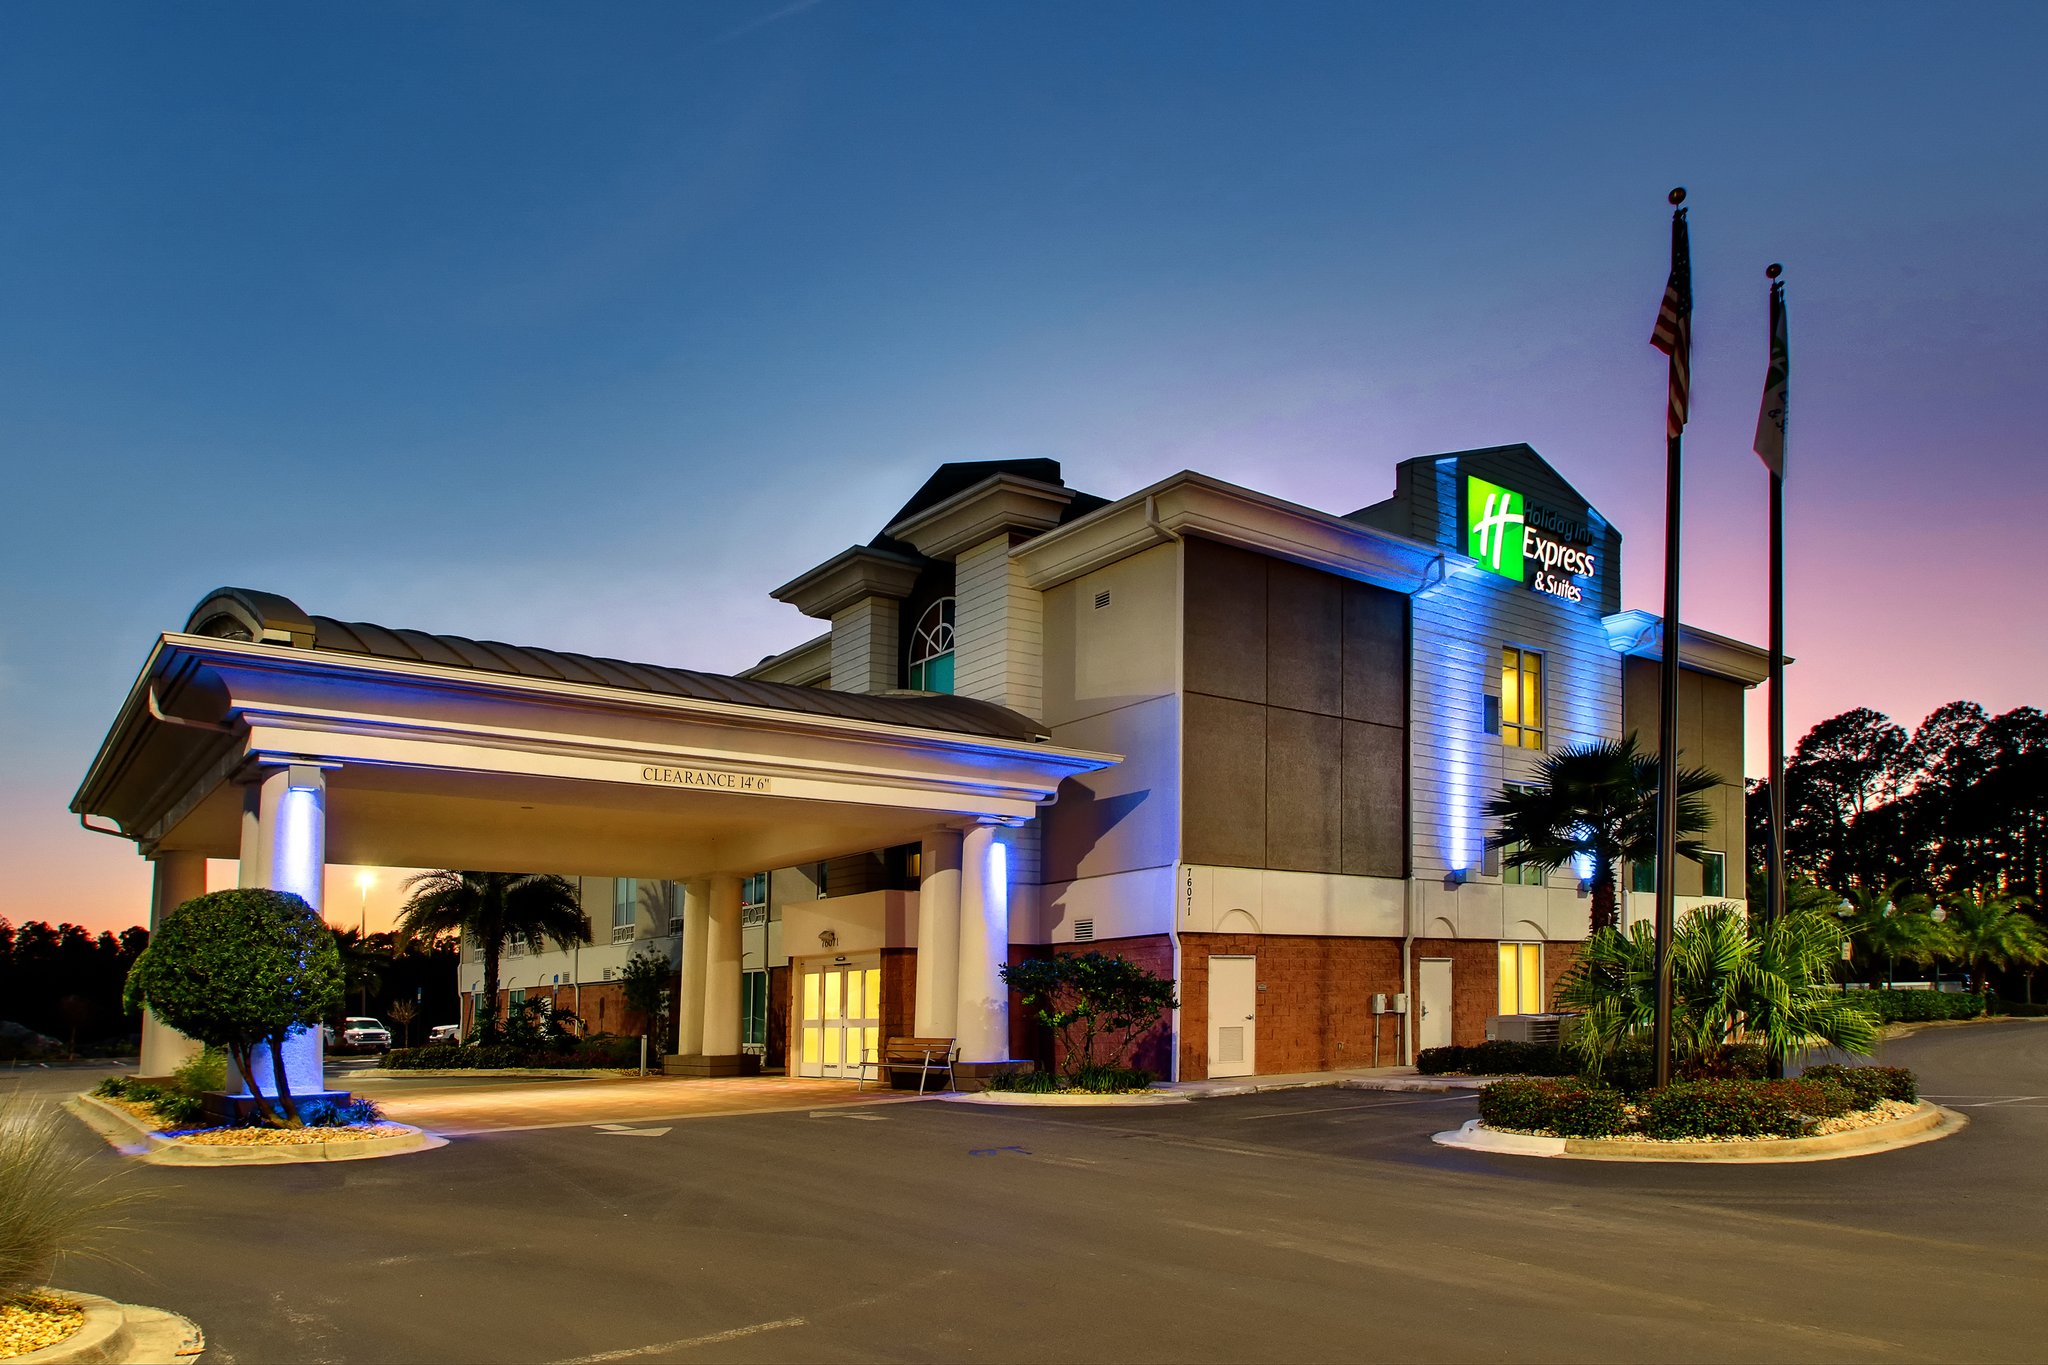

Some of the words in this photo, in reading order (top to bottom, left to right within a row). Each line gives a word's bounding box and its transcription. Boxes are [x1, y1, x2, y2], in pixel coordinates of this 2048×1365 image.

[1524, 500, 1574, 542] Holiday
[1574, 522, 1594, 545] Inn
[1522, 526, 1596, 577] Express
[1534, 571, 1545, 591] &
[1545, 574, 1582, 602] Suites
[643, 767, 736, 788] CLEARANCE
